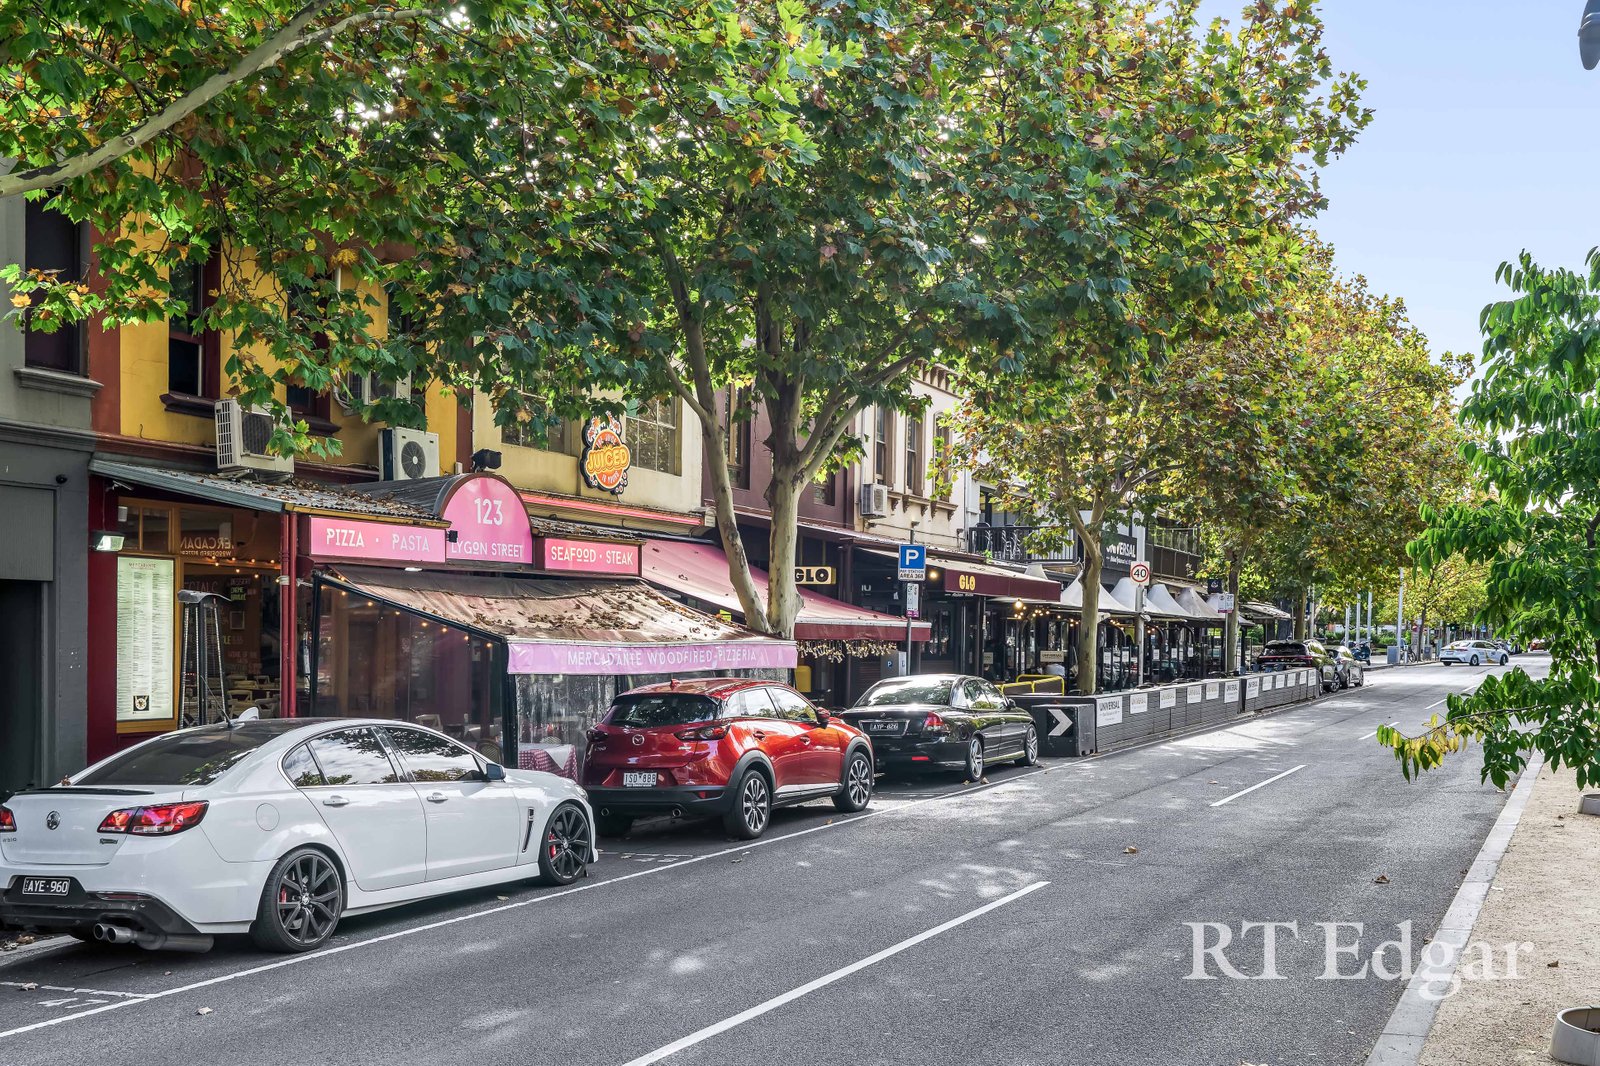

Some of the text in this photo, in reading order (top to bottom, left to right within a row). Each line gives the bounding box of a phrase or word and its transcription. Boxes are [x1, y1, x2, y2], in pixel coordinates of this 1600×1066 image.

[587, 447, 627, 472] JUICED
[474, 497, 504, 526] 123
[326, 528, 430, 552] PIZZA PASTA
[451, 541, 524, 558] LYGON STREET
[551, 545, 634, 565] SEAFOOD STEAK
[905, 549, 919, 566] P
[795, 568, 829, 582] GLO
[1134, 569, 1147, 578] 40
[959, 574, 976, 591] GLO
[567, 648, 757, 666] MERCADANTE WOODFIRED PIZZERIA
